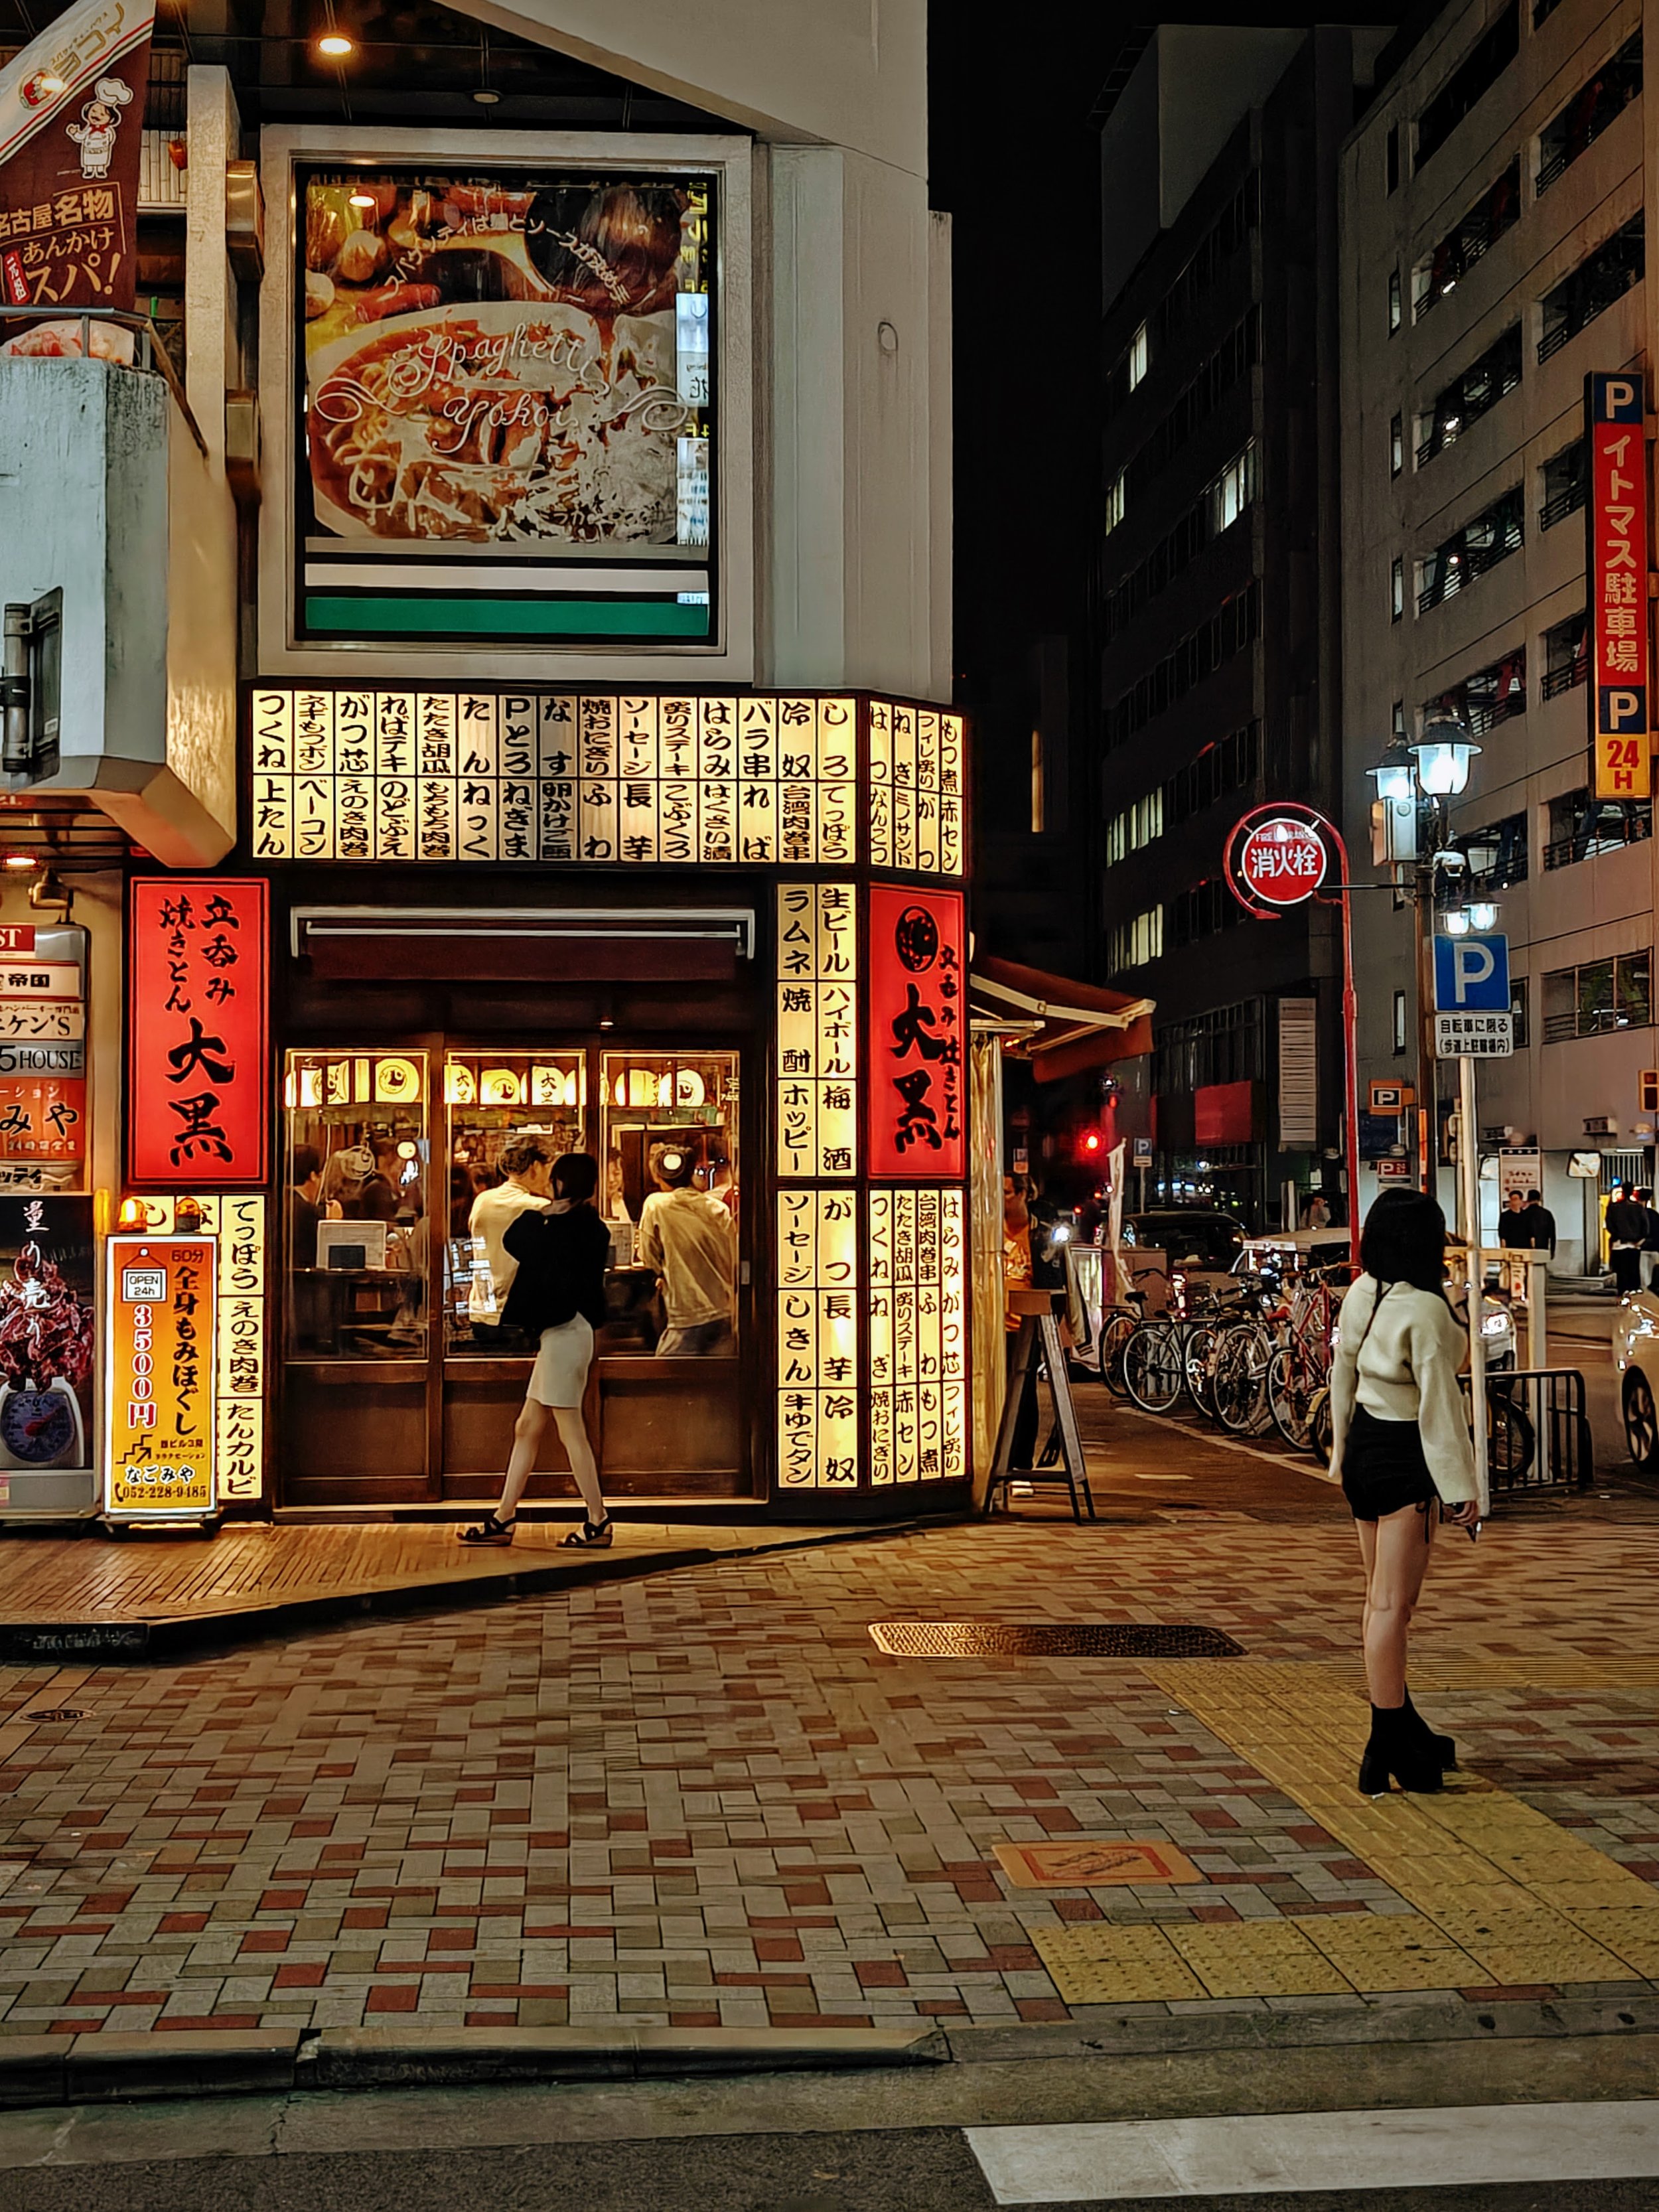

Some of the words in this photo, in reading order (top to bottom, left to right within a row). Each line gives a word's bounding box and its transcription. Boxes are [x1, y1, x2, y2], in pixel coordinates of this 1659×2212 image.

[0, 189, 114, 238] 名古屋名物
[23, 227, 114, 264] あんかけ
[388, 323, 610, 398] Spaghetti
[431, 392, 580, 454] Yokoi
[1606, 382, 1634, 419] P
[1603, 435, 1638, 672] イトマス駐車場
[258, 696, 285, 767] つくね
[340, 695, 370, 773] がつ芯
[379, 698, 409, 769] ればテキ
[422, 697, 450, 773] たたき胡瓜
[463, 699, 490, 773] たん
[504, 698, 531, 774] Pとろ
[542, 698, 572, 775] なす
[582, 699, 612, 776] 焼おにぎり
[623, 700, 651, 775] ソーセージ
[704, 701, 731, 776] はらみ
[743, 701, 771, 777] バラ串
[782, 701, 810, 777] 冷奴
[824, 703, 848, 776] しろ
[870, 707, 887, 776] はつ
[894, 714, 912, 784] ねぎ
[1609, 692, 1638, 730] P
[941, 720, 957, 792] もつ煮
[1607, 740, 1640, 769] 24
[1614, 771, 1632, 790] H
[257, 778, 286, 855] 上たん
[299, 780, 327, 855] ベーコン
[380, 781, 410, 856] のどぶえ
[463, 782, 490, 857] ねっく
[503, 782, 533, 858] ねぎま
[583, 783, 611, 858] ふわ
[622, 784, 653, 860] 長芋
[664, 784, 692, 859] こぶくろ
[743, 785, 771, 860] れば
[822, 786, 847, 859] てっぽう
[870, 789, 887, 862] なんこつ
[895, 792, 912, 865] ミノサンド
[919, 797, 935, 868] がつ
[941, 802, 958, 871] 赤セン
[1251, 844, 1318, 879] 消火栓
[159, 894, 196, 1013] 焼きとん
[201, 894, 239, 1006] 立呑み
[783, 891, 810, 974] ラムネ
[822, 888, 851, 972] 生ビール
[1455, 942, 1494, 1003] P
[783, 988, 811, 1072] 焼酎
[823, 988, 850, 1073] ハイボール
[890, 982, 943, 1154] 大黒
[164, 1016, 236, 1167] 大黒
[784, 1084, 811, 1171] ホッピー
[823, 1086, 851, 1171] 梅酒
[1378, 1090, 1395, 1105] P
[1137, 1139, 1149, 1154] P
[1380, 1163, 1394, 1175] P
[23, 1199, 50, 1347] 量り売り
[171, 1249, 205, 1264] 60分
[231, 1200, 261, 1290] てっぽう
[784, 1196, 812, 1283] ソーセージ
[824, 1197, 852, 1280] がつ
[871, 1197, 889, 1279] つくね
[896, 1194, 912, 1282] たたき胡瓜
[943, 1197, 959, 1278] はらみ
[129, 1276, 159, 1285] OPEN
[133, 1286, 155, 1296] 24h
[131, 1304, 156, 1428] 3500円
[173, 1266, 200, 1436] 全身もみほぐし
[786, 1295, 811, 1381] しきん
[824, 1295, 851, 1380] 長芋
[871, 1295, 889, 1378] ねぎ
[920, 1293, 936, 1374] ふわ
[942, 1293, 960, 1375] がつ芯
[226, 1403, 257, 1495] たんカルビ
[784, 1394, 813, 1483] 牛ゆでタン
[826, 1395, 854, 1482] 冷奴
[871, 1390, 890, 1480] 焼おにぎり
[895, 1391, 913, 1475] 赤セン
[920, 1390, 938, 1473] もつ煮
[126, 1465, 195, 1484] なごみや
